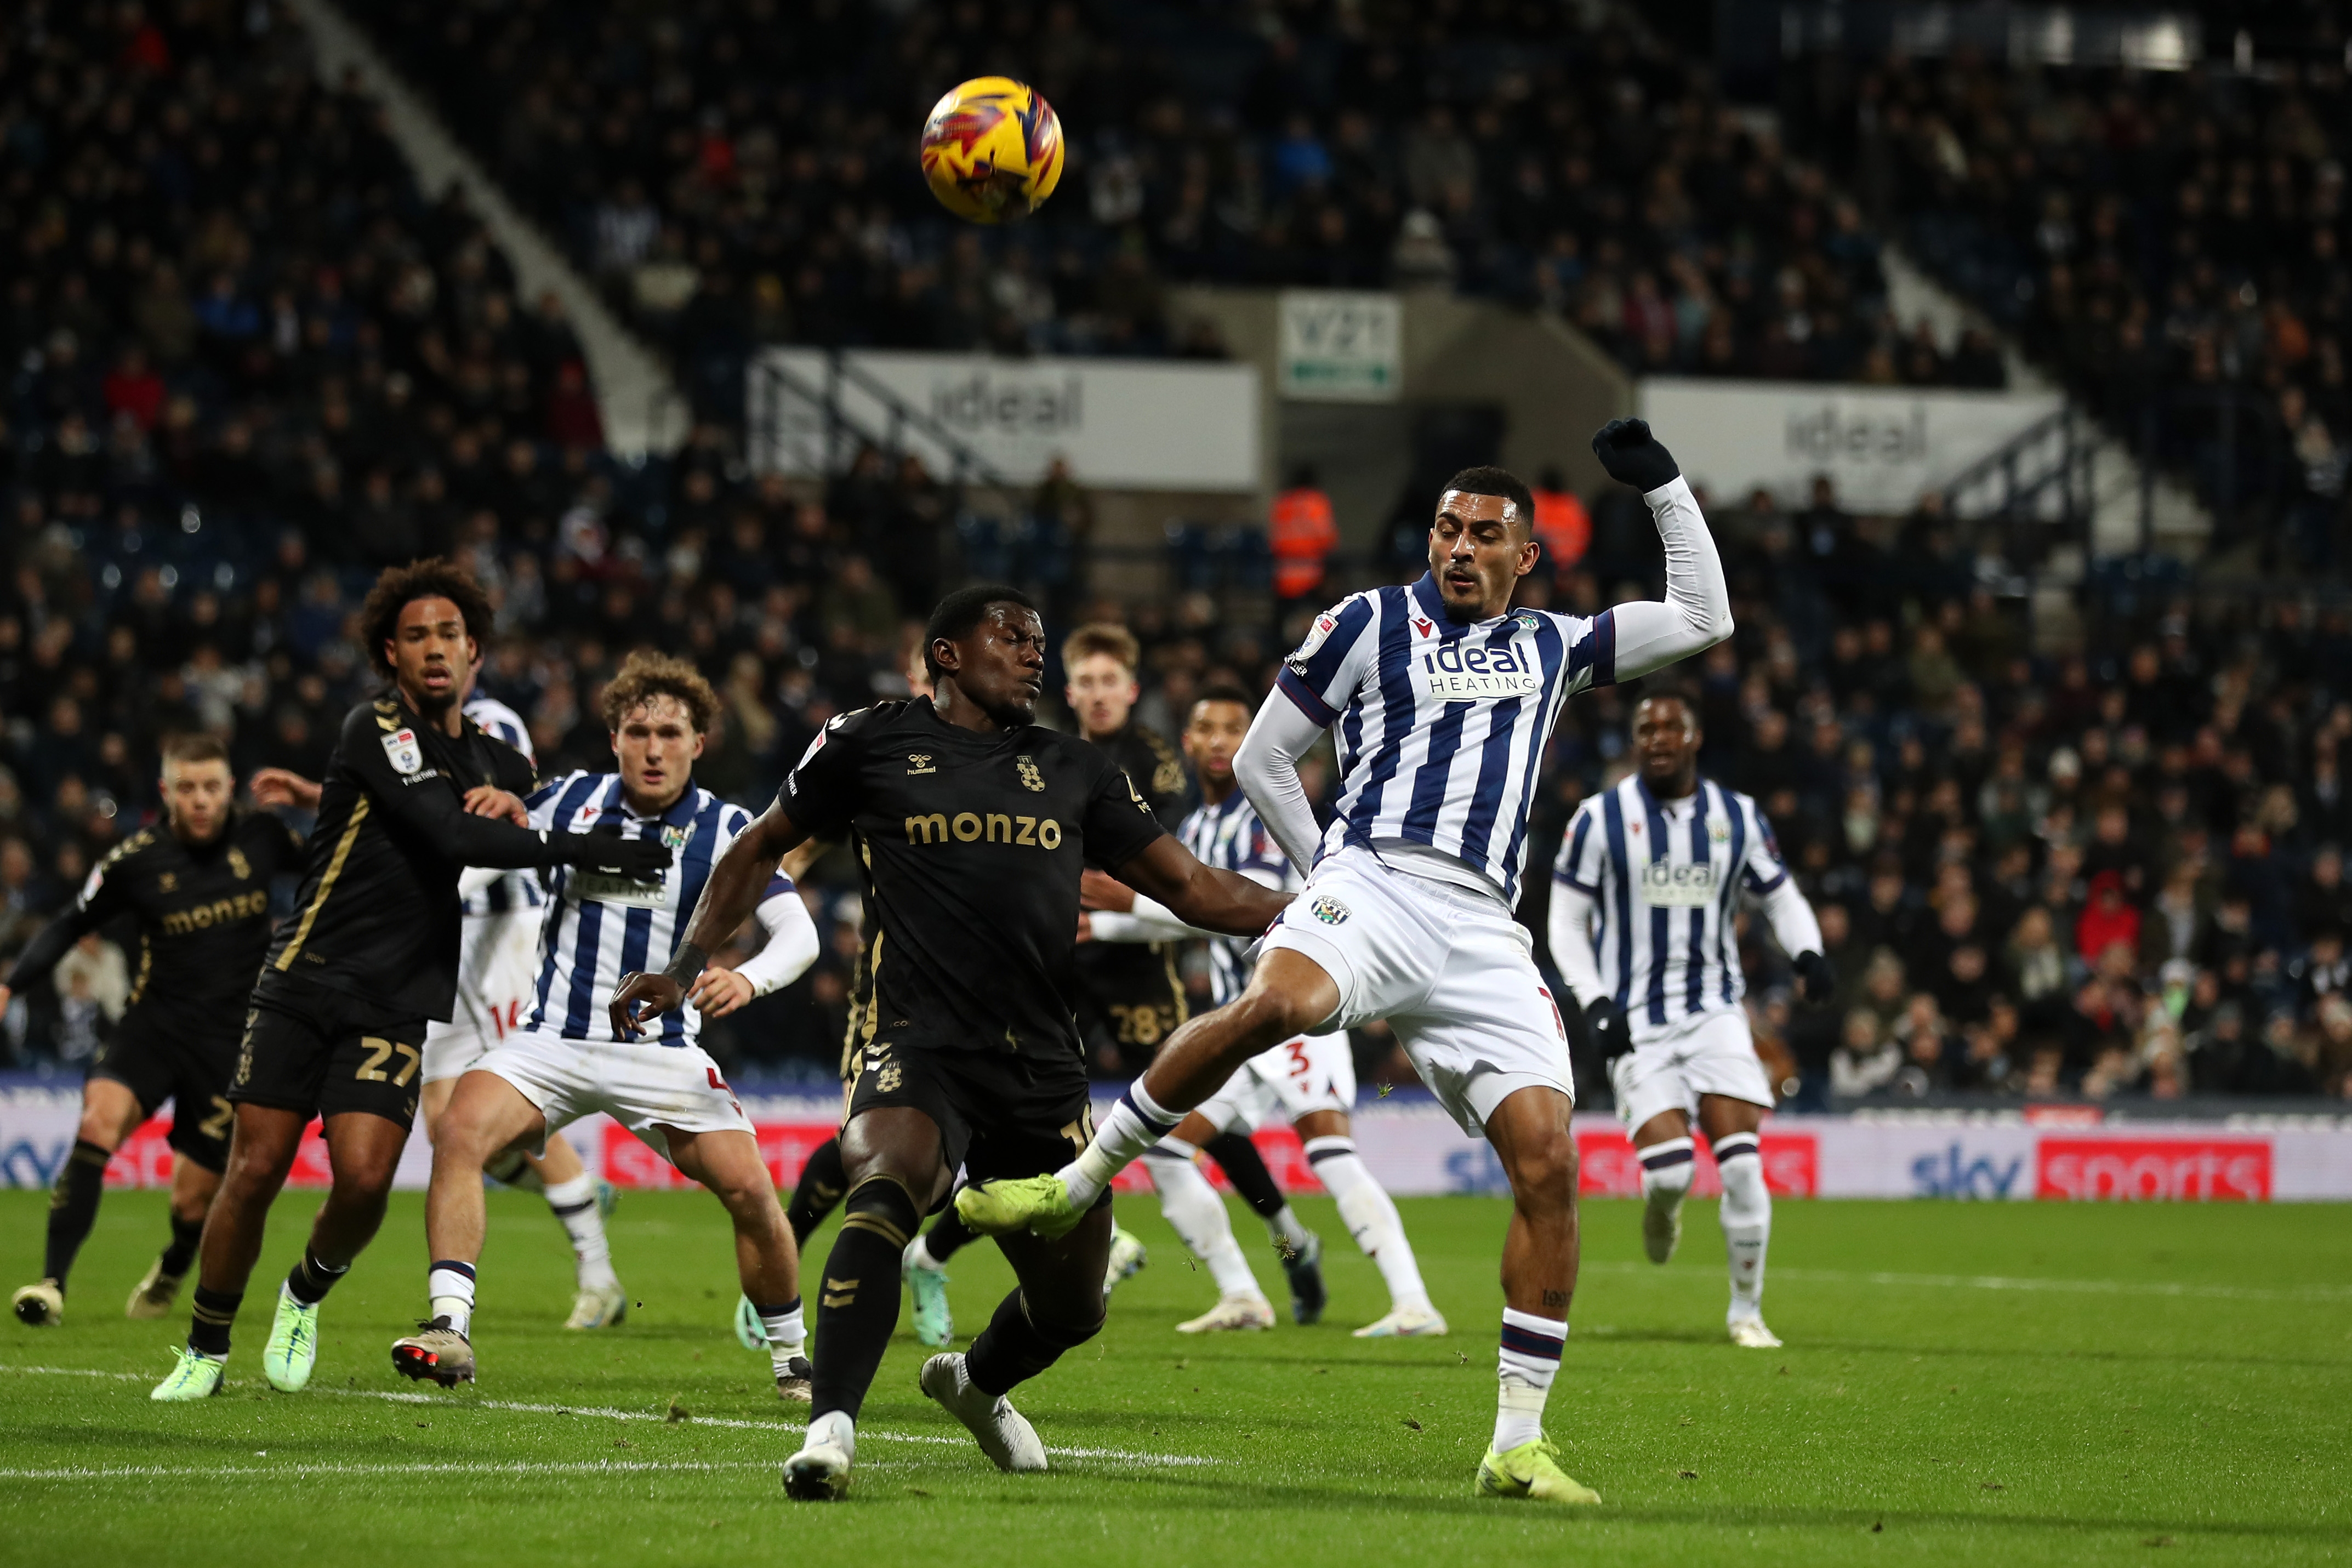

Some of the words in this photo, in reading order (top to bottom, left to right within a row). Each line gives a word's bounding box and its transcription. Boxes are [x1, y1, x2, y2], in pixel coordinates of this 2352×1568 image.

[931, 374, 1083, 433] ideal
[1785, 403, 1926, 464] ideal
[1424, 638, 1530, 674] ideal
[1430, 676, 1536, 693] HEATING
[907, 766, 936, 776] hummel
[905, 812, 1061, 850] monzo
[1642, 852, 1721, 888] ideal
[163, 890, 267, 934] monzo
[1318, 896, 1349, 915] ALBION
[1109, 1004, 1161, 1045] 28
[355, 1036, 420, 1087] 27
[1285, 1042, 1309, 1076] 3
[199, 1096, 234, 1141] 2
[1910, 1143, 2021, 1199] sky
[2047, 1150, 2263, 1200] sports
